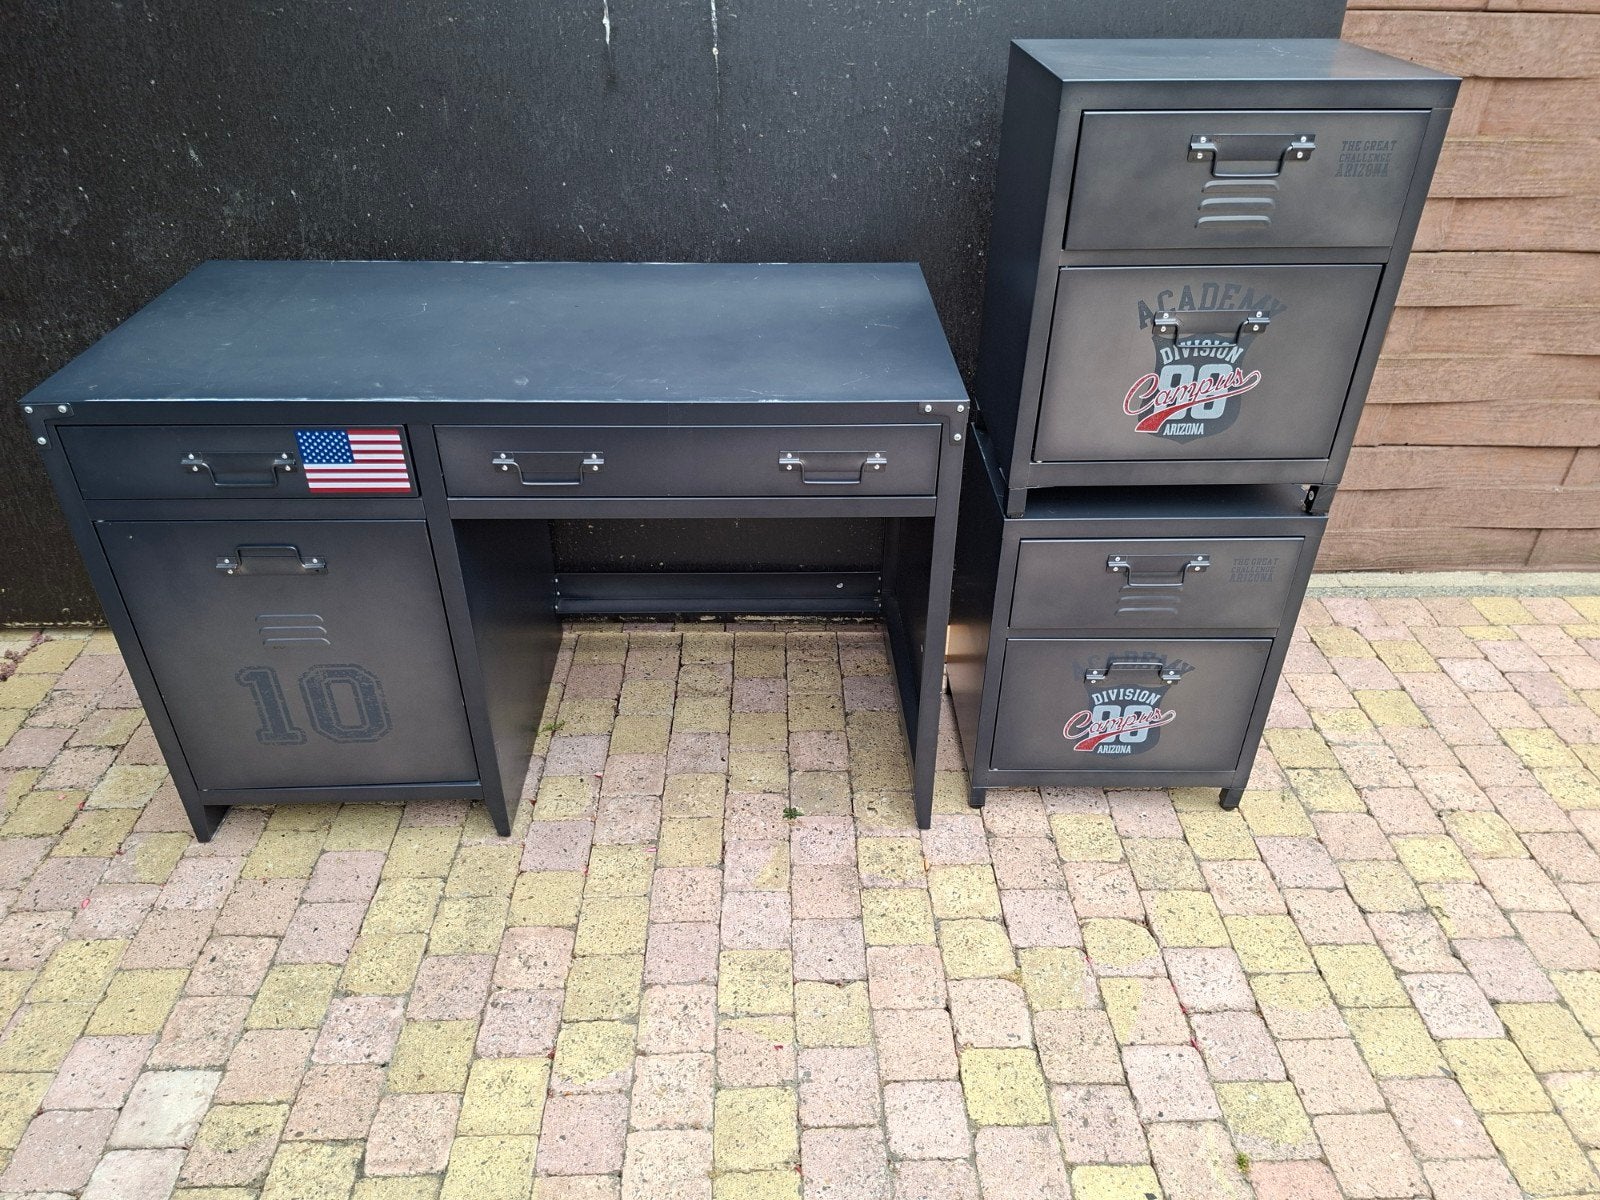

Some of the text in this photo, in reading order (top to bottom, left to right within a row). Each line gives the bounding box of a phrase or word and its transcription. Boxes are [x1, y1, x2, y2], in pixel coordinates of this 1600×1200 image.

[1342, 140, 1397, 151] THE GREAT
[1339, 153, 1392, 163] CHALLENGE
[1335, 163, 1389, 177] ARIZONA
[1160, 339, 1244, 365] DIVISION
[1123, 368, 1261, 416] Campus
[1163, 423, 1204, 436] ARIZONA
[1092, 688, 1161, 705] DIVISION
[235, 664, 393, 745] 10
[1063, 708, 1176, 740] Campus
[1097, 744, 1131, 754] ARIZONA
